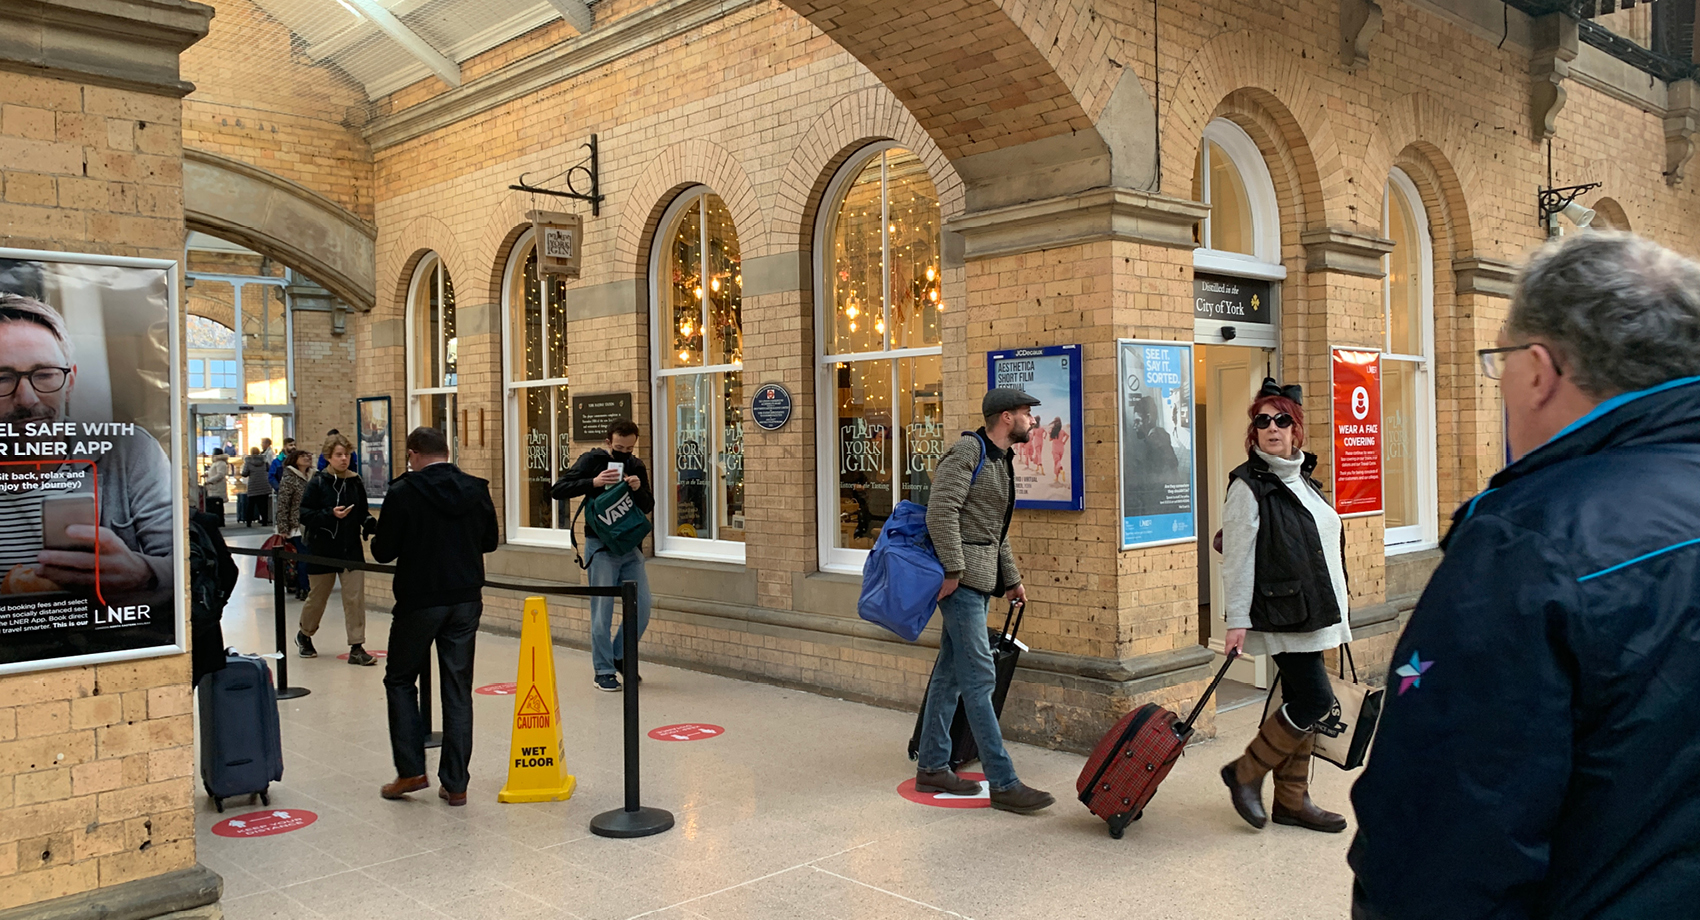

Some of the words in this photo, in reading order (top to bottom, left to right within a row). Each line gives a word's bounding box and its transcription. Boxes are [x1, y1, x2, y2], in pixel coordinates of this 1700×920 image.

[551, 246, 569, 255] GIN
[1202, 281, 1225, 293] Distilled
[1226, 285, 1231, 294] in
[1231, 285, 1239, 294] the
[1196, 297, 1214, 316] City
[1215, 300, 1226, 313] of
[1225, 301, 1245, 315] York
[1145, 348, 1160, 360] SEE
[1161, 349, 1170, 360] IT.
[998, 361, 1035, 372] AESTHETICA
[1146, 360, 1161, 371] SAY
[1162, 361, 1171, 372] IT.
[998, 373, 1018, 383] SHORT
[1019, 372, 1034, 382] FILM
[1146, 372, 1180, 384] SORTED.
[25, 422, 76, 436] SAFE
[82, 422, 134, 436] WITH
[1338, 425, 1358, 434] WEAR
[1359, 425, 1364, 434] A
[1365, 424, 1378, 434] FACE
[845, 440, 881, 454] YORK
[1344, 436, 1375, 446] COVERING
[14, 442, 68, 456] LNER
[72, 441, 113, 455] APP
[526, 455, 545, 469] GIN
[678, 454, 703, 470] GIN
[846, 454, 879, 472] GIN
[911, 454, 941, 472] GI
[12, 472, 39, 480] back,
[40, 471, 64, 479] relax
[41, 481, 81, 490] journey)
[902, 482, 921, 491] History
[597, 491, 634, 526] VANS
[8, 603, 36, 611] booking
[12, 610, 37, 618] socially
[39, 607, 72, 616] distanced
[94, 604, 150, 624] LNER
[9, 618, 29, 626] LNER
[2, 626, 22, 634] travel
[23, 624, 51, 632] smarter.
[517, 715, 550, 729] CAUTION
[521, 746, 546, 756] WET
[515, 758, 554, 768] FLOOR
[237, 825, 267, 833] KEEP
[245, 821, 304, 835] DISTANCE
